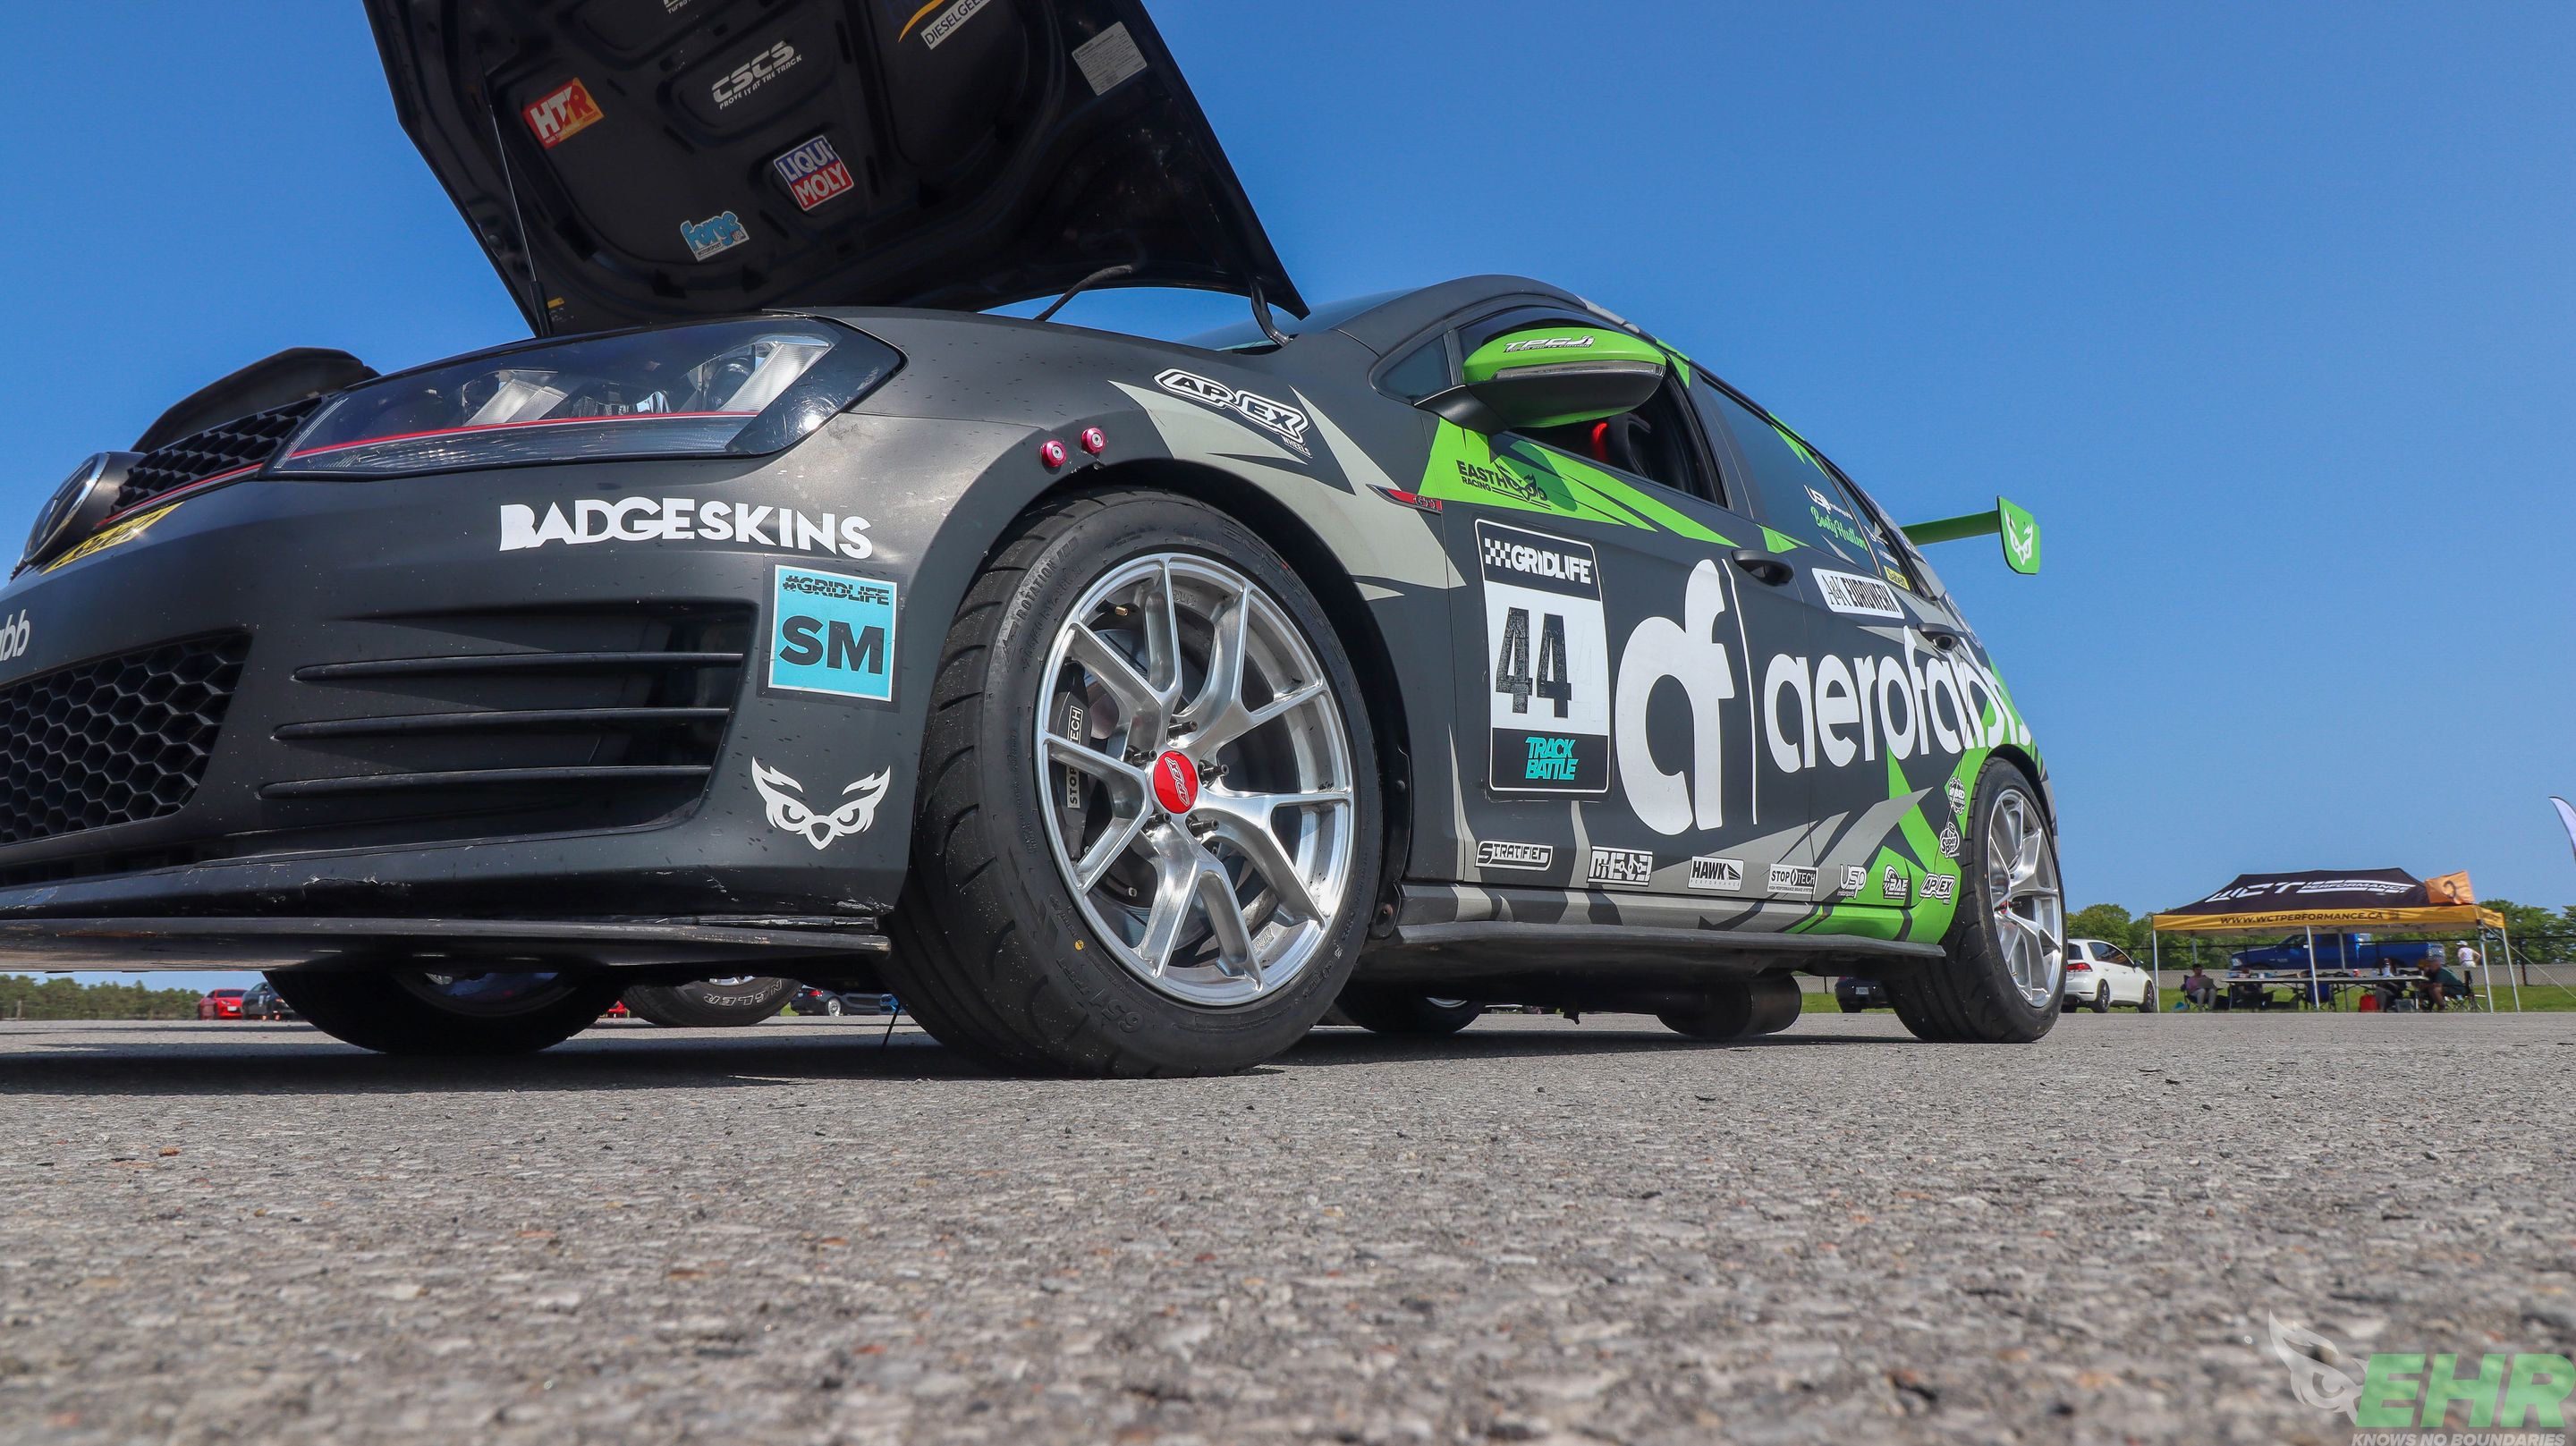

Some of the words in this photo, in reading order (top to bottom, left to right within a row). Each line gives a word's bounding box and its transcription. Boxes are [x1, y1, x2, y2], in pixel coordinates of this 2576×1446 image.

[711, 40, 795, 103] CSCS
[719, 93, 742, 110] PROVE
[743, 88, 752, 97] IT
[752, 80, 761, 91] AT
[762, 70, 775, 83] THE
[775, 55, 802, 74] TRACK
[530, 85, 594, 139] HTR
[778, 140, 835, 182] LIQUI
[794, 162, 847, 206] MOLY
[1461, 476, 1492, 492] RACING
[498, 497, 874, 560] BADGESKINS
[1511, 545, 1592, 585] GRIDLIFE
[781, 575, 891, 606] #GRIDLIFE
[1016, 560, 1058, 621] ROTATION
[777, 615, 886, 675] SM
[1496, 606, 1572, 719] 44
[1524, 736, 1577, 759] TRACK
[1524, 757, 1579, 781] BATTLE
[1690, 879, 1741, 887] PERFORMANCE
[1691, 861, 1727, 880] HAWK
[2301, 883, 2411, 892] PERFORMANCE
[2220, 912, 2384, 925] WWW.WCTPERFORMANCE.CA
